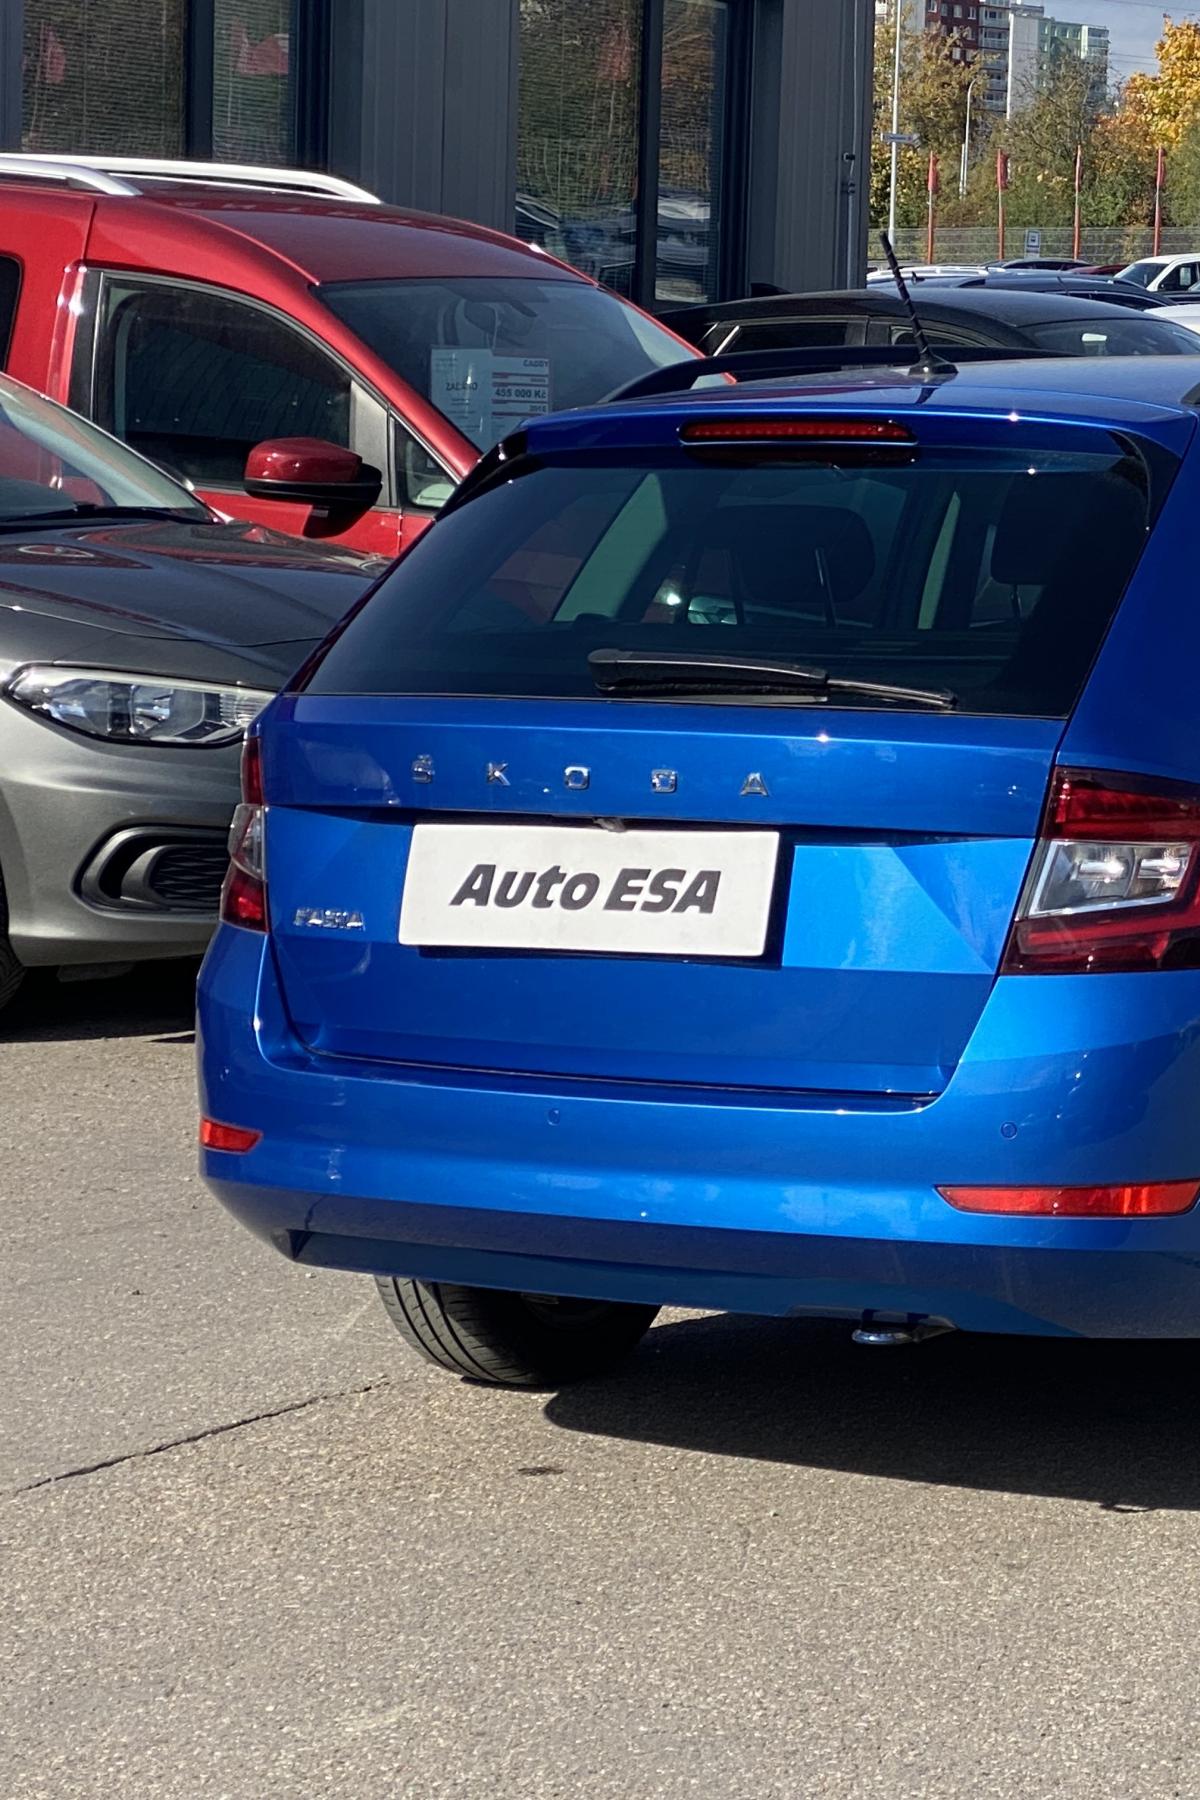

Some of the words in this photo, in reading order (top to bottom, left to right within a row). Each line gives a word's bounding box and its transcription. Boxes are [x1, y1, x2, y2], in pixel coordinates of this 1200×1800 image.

[411, 754, 770, 798] ŠKODA
[449, 863, 600, 911] Auto
[603, 867, 721, 914] ESA
